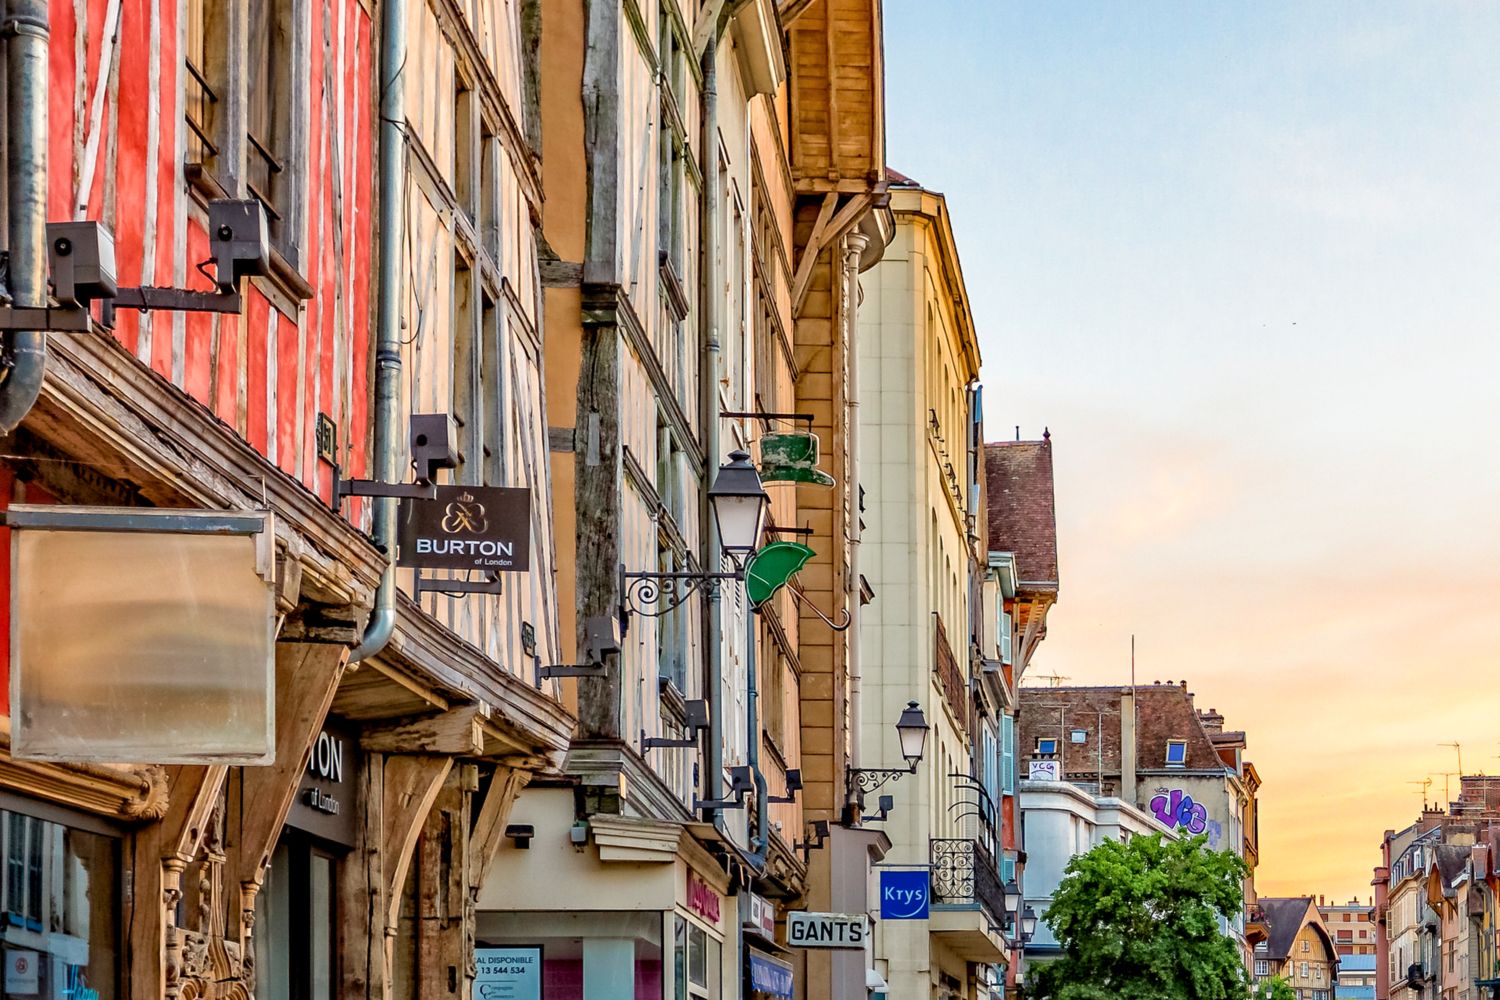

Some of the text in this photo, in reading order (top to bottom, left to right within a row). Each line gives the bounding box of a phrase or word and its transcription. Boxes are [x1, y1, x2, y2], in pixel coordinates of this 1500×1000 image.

[416, 538, 513, 557] BURTON
[485, 558, 512, 566] London
[884, 886, 923, 905] Krys
[791, 920, 863, 943] GANTS
[488, 956, 534, 964] DISPONIBLE
[493, 966, 508, 974] 544
[510, 966, 526, 974] 534
